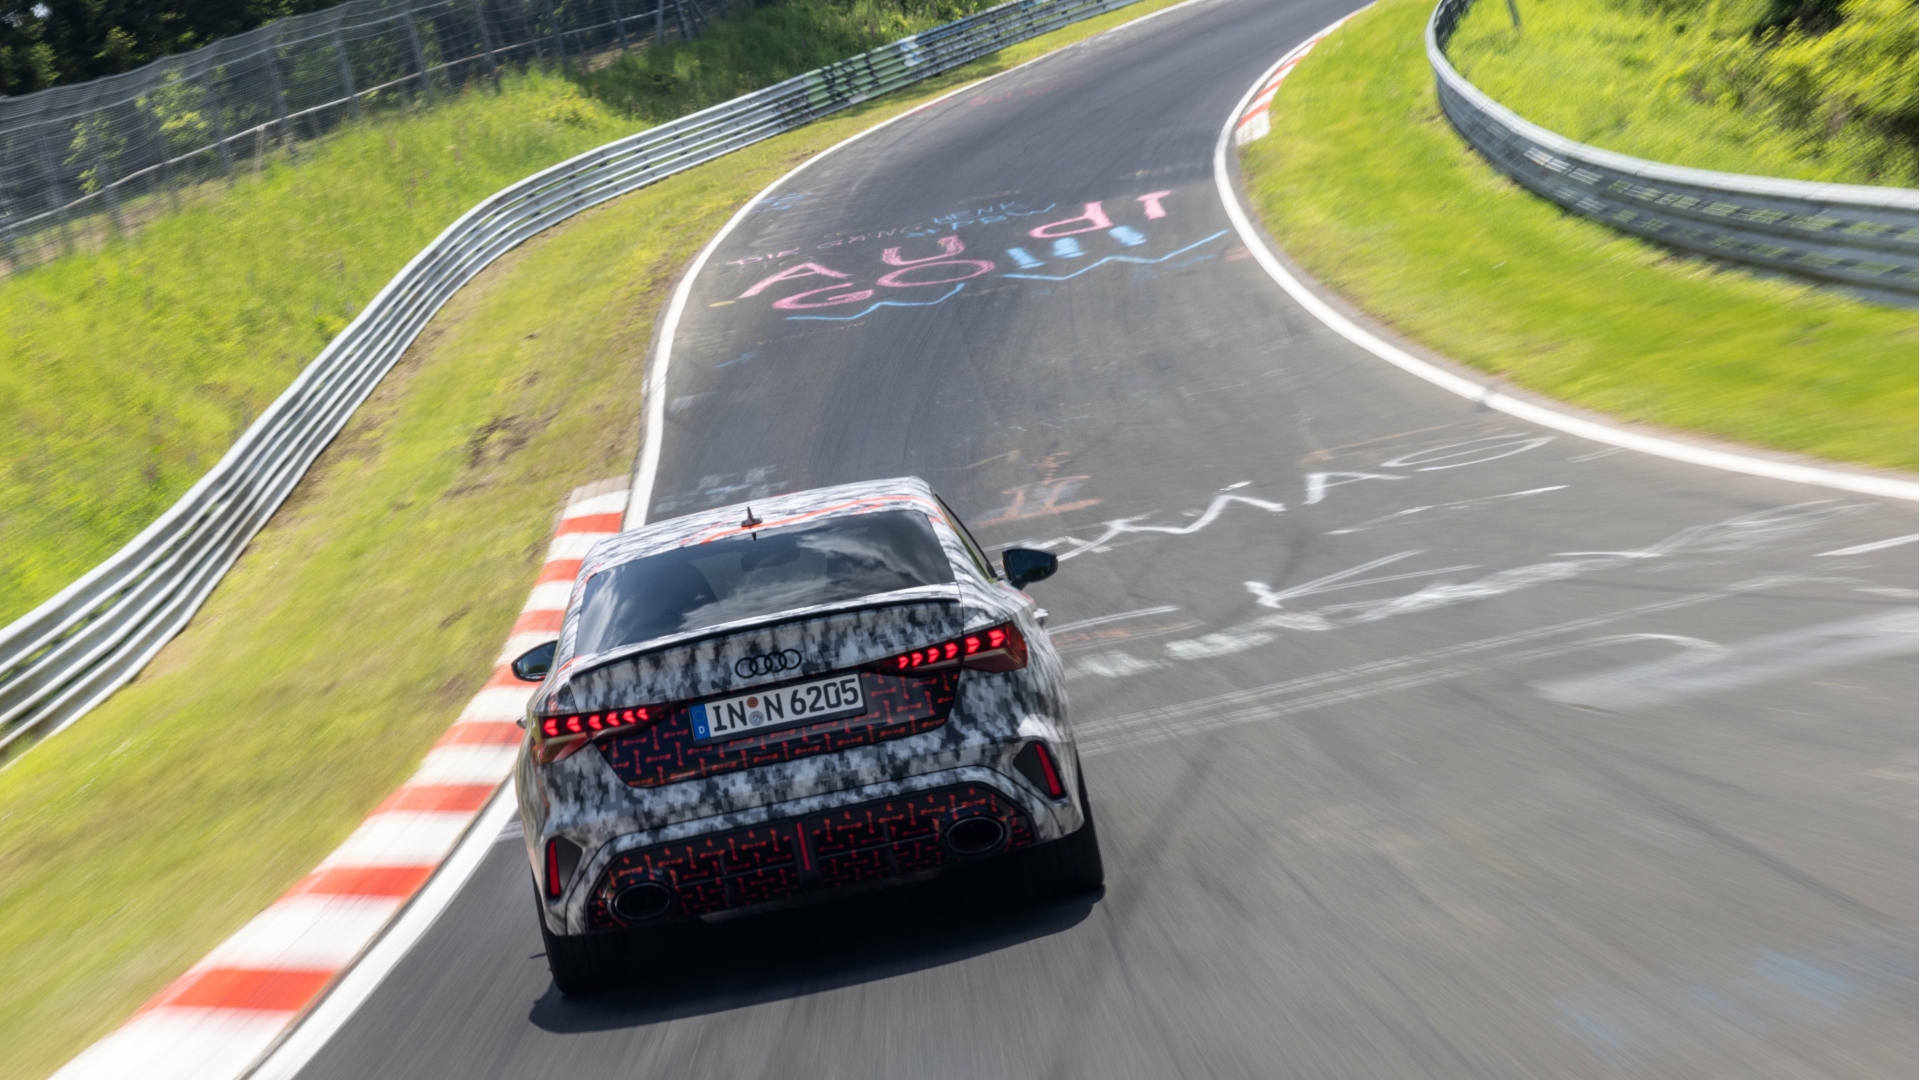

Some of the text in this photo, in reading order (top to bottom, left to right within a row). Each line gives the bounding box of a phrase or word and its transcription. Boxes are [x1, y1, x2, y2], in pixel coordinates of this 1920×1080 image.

[713, 678, 859, 733] IN N 6205
[698, 726, 706, 734] D
